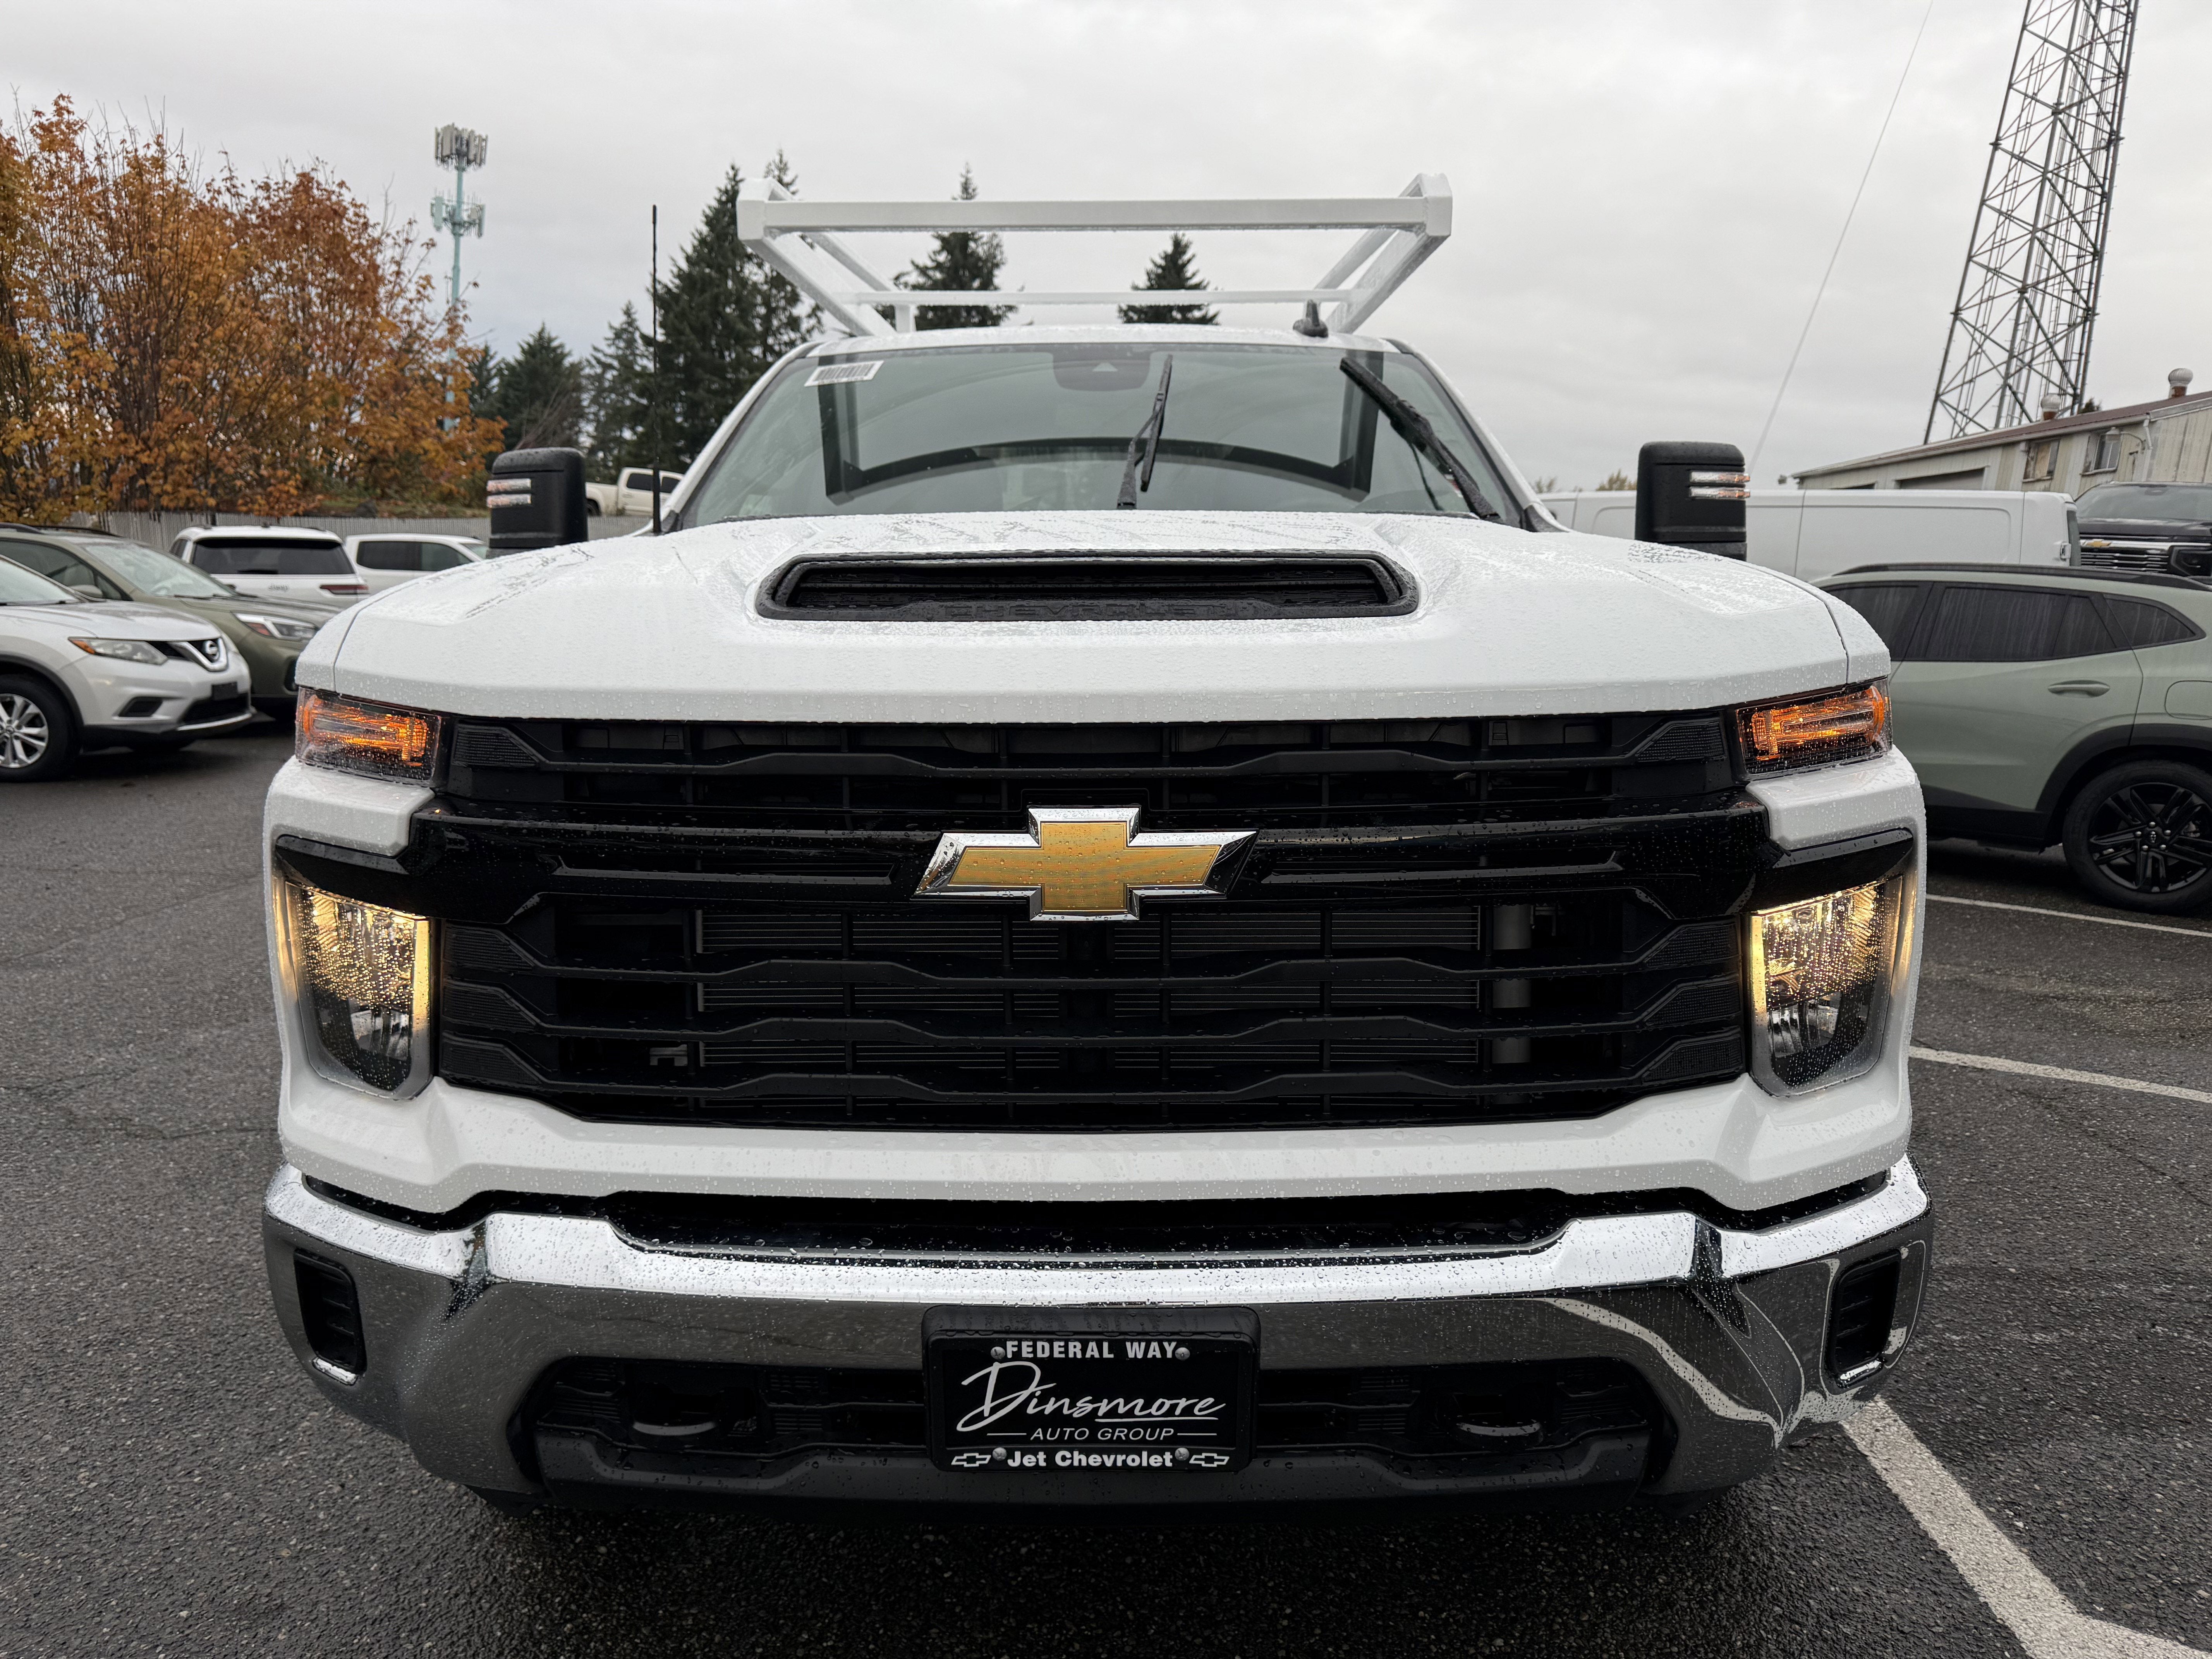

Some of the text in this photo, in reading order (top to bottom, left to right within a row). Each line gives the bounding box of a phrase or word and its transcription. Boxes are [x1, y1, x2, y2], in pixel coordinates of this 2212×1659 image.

[945, 604, 1226, 617] CHEVROLET
[1006, 1340, 1177, 1359] FEDERAL WAY
[956, 1360, 1226, 1432] Dinsmore
[1030, 1427, 1174, 1441] AUTO GROUP
[1007, 1450, 1173, 1467] Jet Chevrolet
